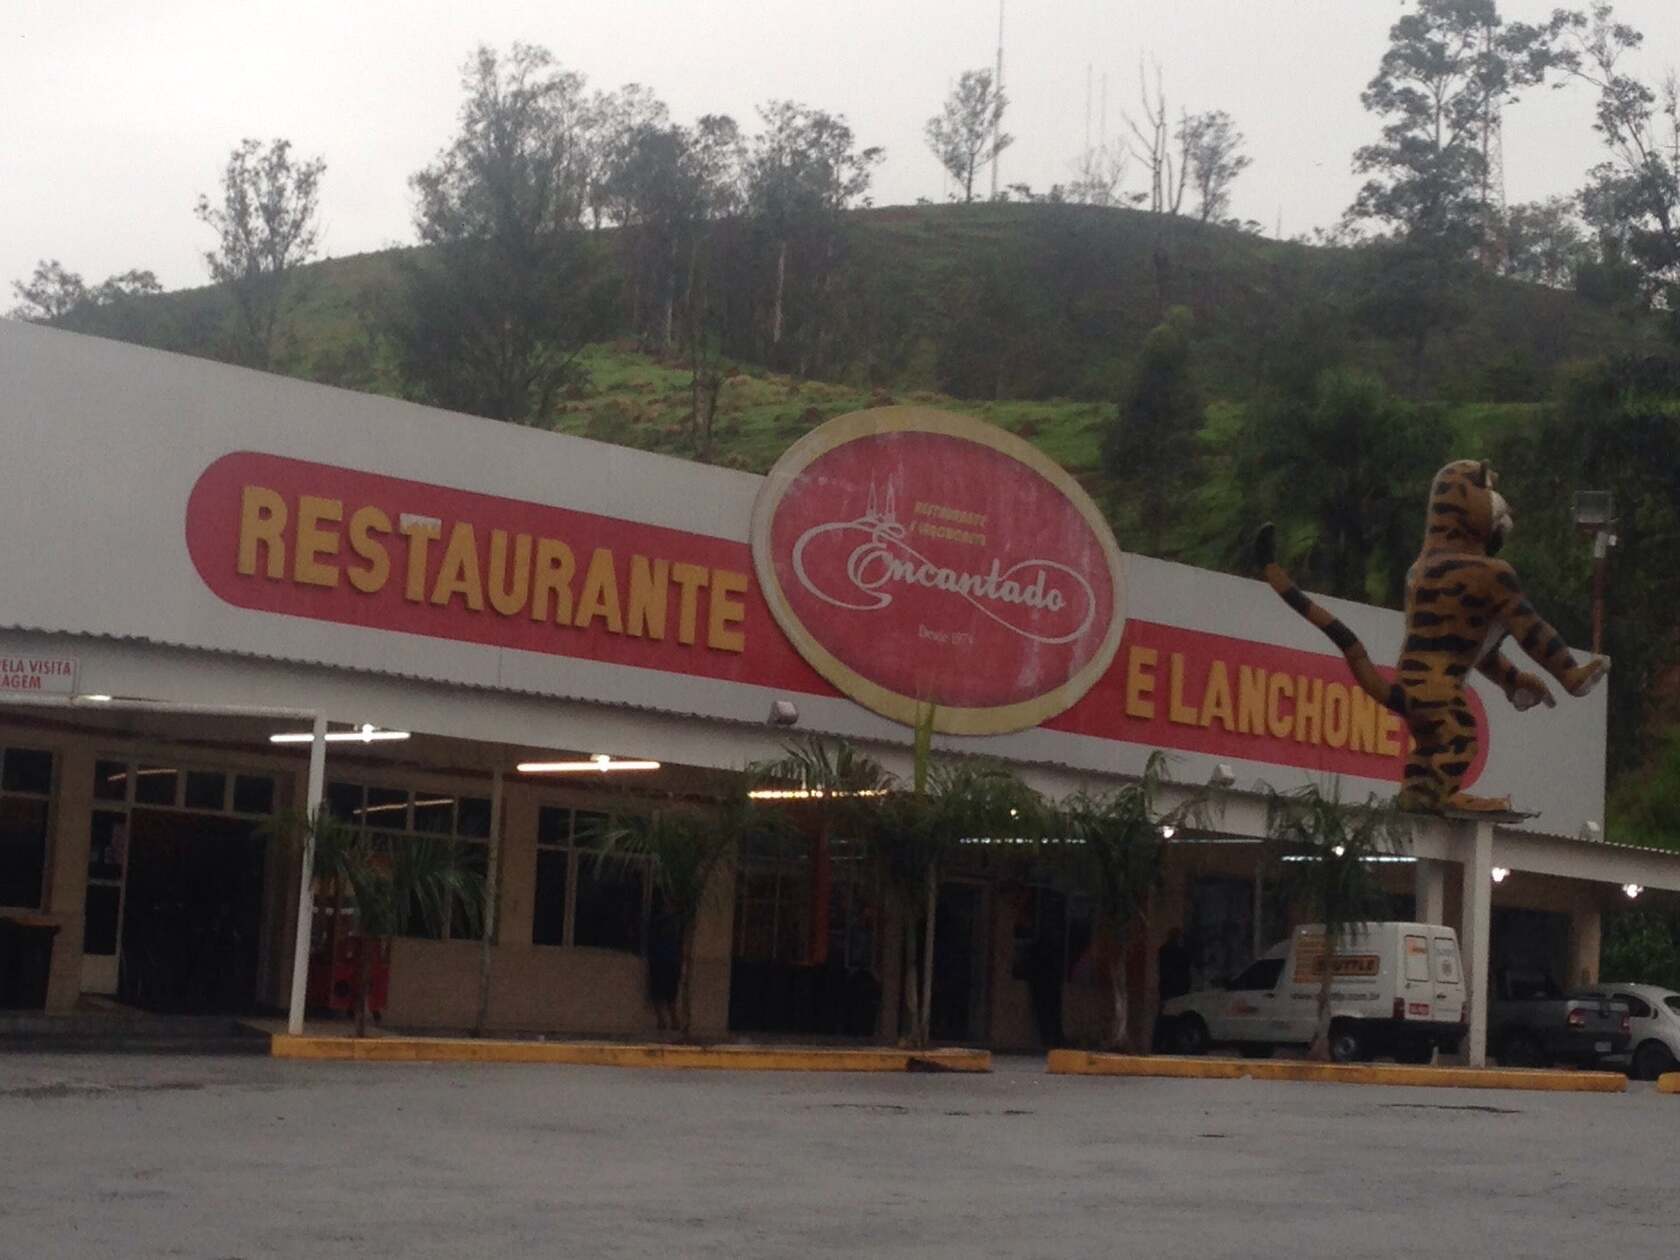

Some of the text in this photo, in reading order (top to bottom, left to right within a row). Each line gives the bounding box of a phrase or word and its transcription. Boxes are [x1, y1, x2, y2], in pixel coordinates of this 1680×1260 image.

[237, 485, 748, 653] RESTAURANTE
[846, 541, 1066, 613] Encantado
[0, 658, 72, 676] ELA VISITA
[0, 674, 42, 690] AGEM
[1126, 645, 1405, 757] E LANCHONE
